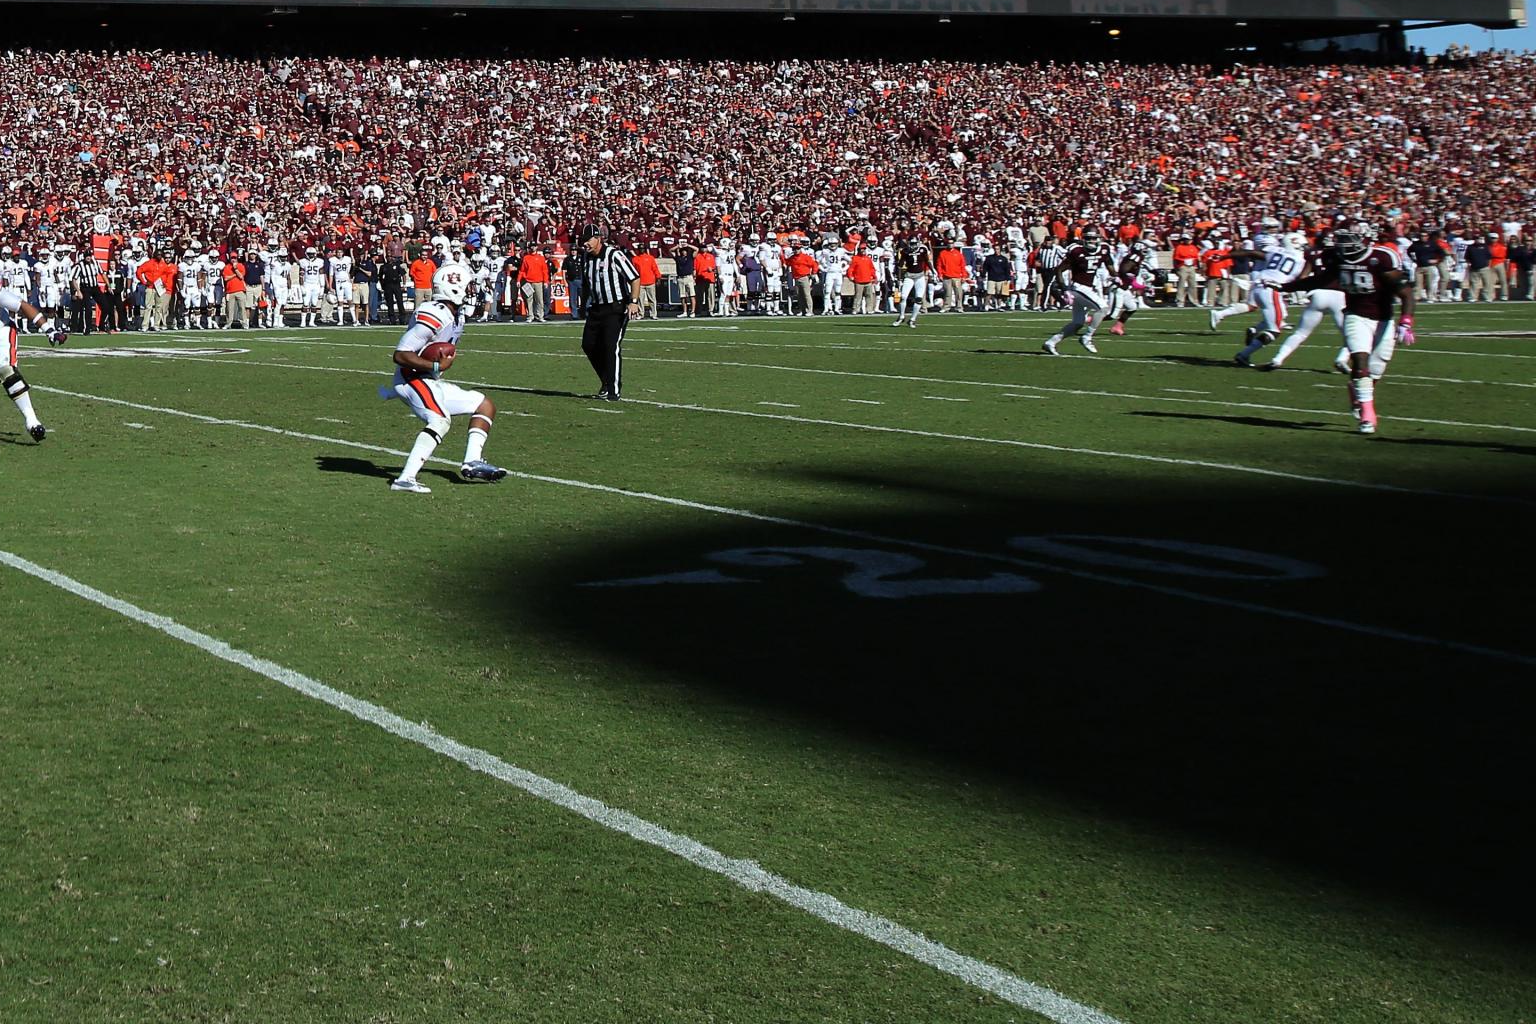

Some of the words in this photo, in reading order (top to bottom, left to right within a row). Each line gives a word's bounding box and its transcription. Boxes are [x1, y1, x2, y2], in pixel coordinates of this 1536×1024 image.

[1087, 259, 1098, 274] 5
[1268, 252, 1296, 276] 80
[13, 267, 23, 276] 12
[187, 269, 196, 279] 21
[209, 268, 220, 278] 20
[307, 266, 318, 276] 25
[1005, 534, 1329, 580] 0
[703, 545, 1044, 599] 2
